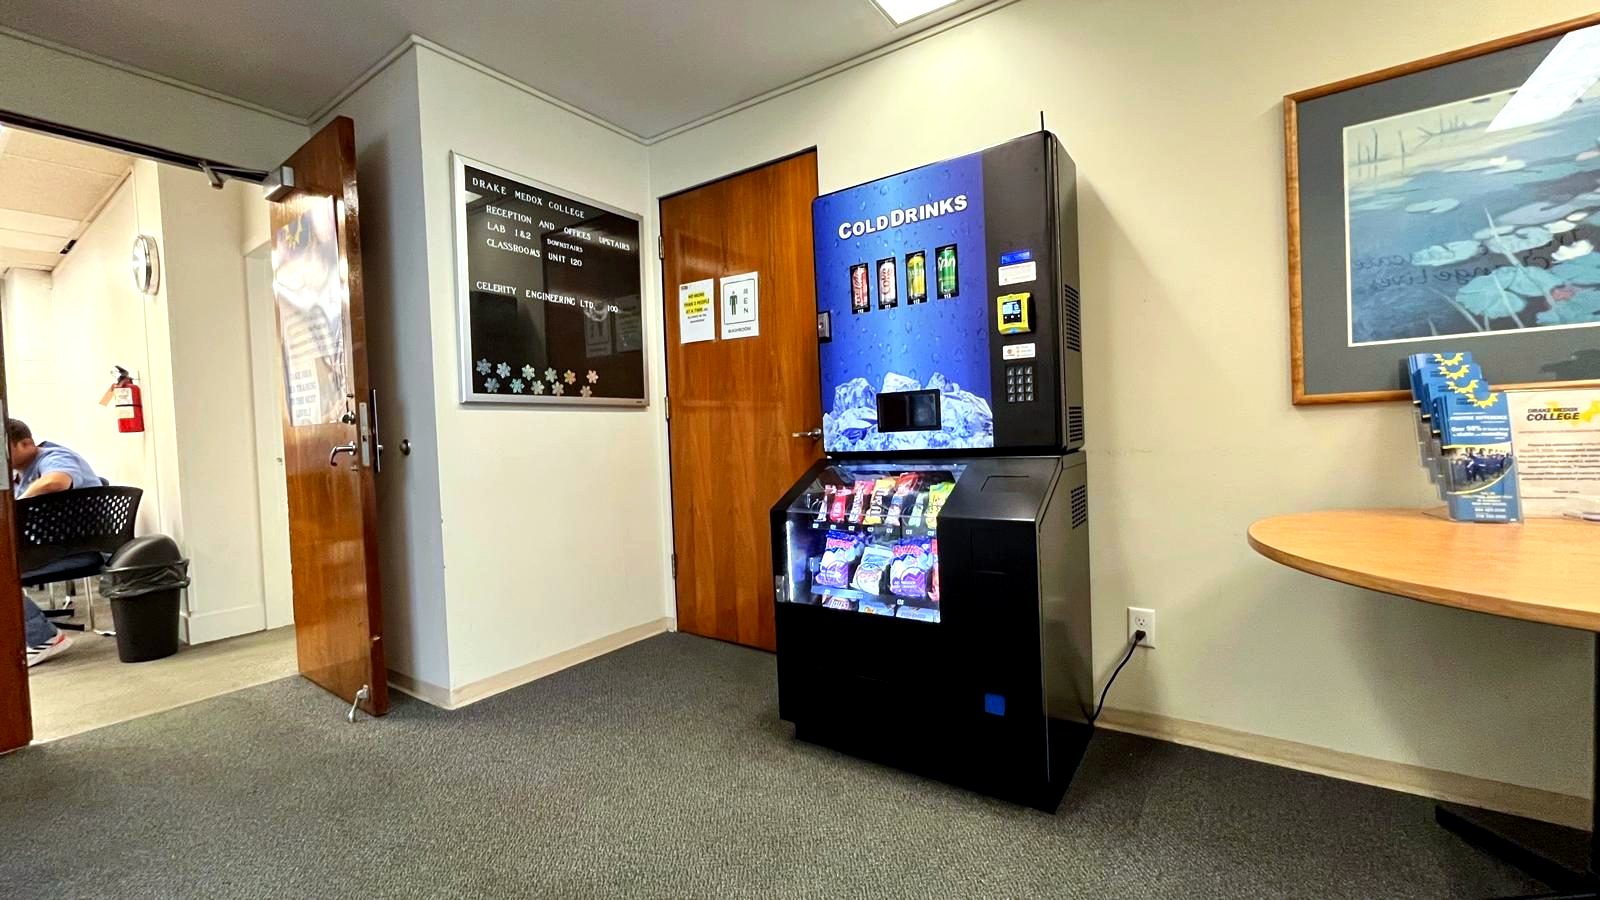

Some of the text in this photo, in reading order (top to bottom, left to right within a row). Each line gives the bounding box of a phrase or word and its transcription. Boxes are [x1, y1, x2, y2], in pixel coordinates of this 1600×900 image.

[472, 177, 585, 219] DRAKE MEDOX COLLEGE
[486, 204, 631, 251] RECEPTION AND OFFICES UPSTAIRS
[487, 221, 506, 234] LAB
[546, 238, 584, 253] DOWNSTAIRS
[486, 238, 583, 267] CLASSROOMS UNIT 120
[476, 280, 517, 295] CELERITY
[525, 289, 576, 306] ENGINEERING
[607, 304, 619, 313] 100
[1526, 412, 1580, 422] COLLEGE
